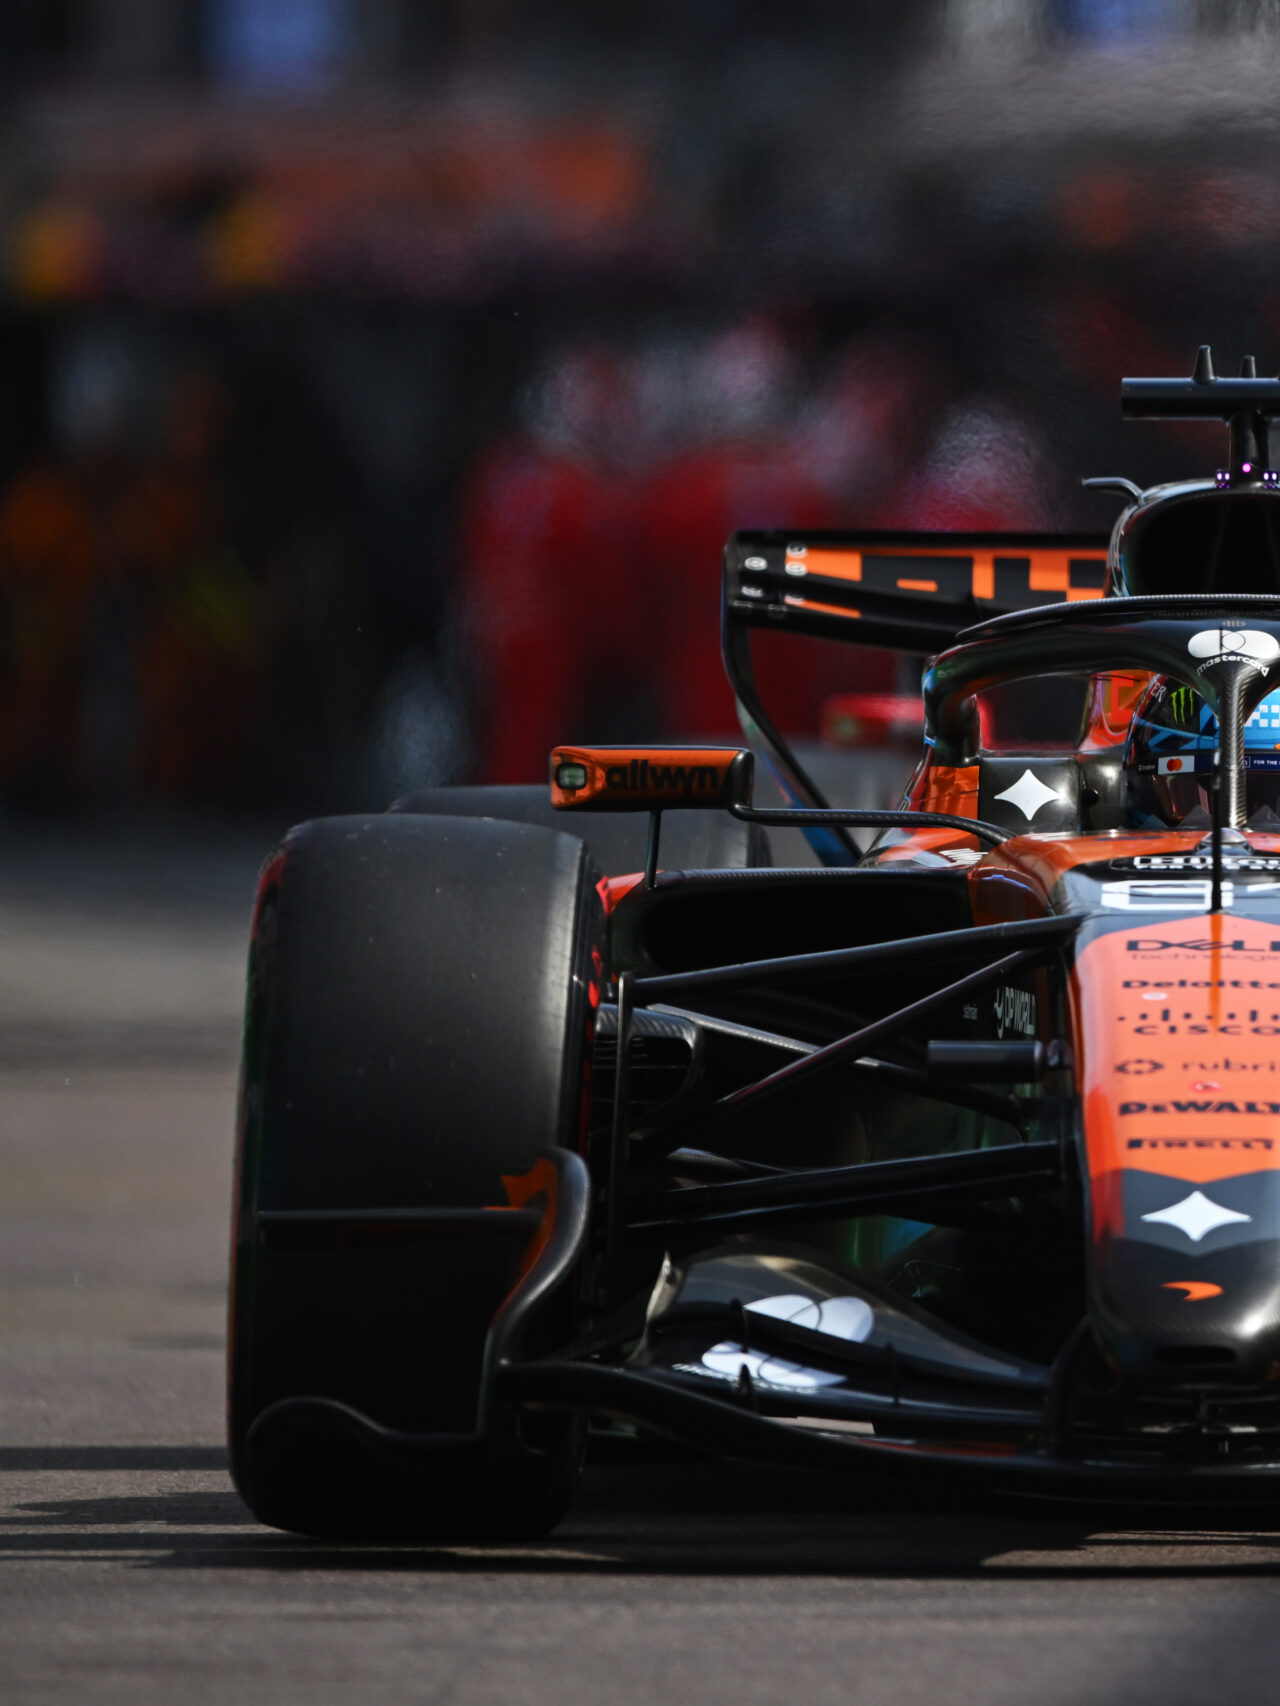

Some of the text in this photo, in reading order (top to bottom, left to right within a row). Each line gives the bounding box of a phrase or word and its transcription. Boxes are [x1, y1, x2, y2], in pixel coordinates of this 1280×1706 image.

[1196, 655, 1269, 677] mastercard
[605, 759, 718, 797] allwyn
[1127, 1138, 1275, 1150] PIRELLI
